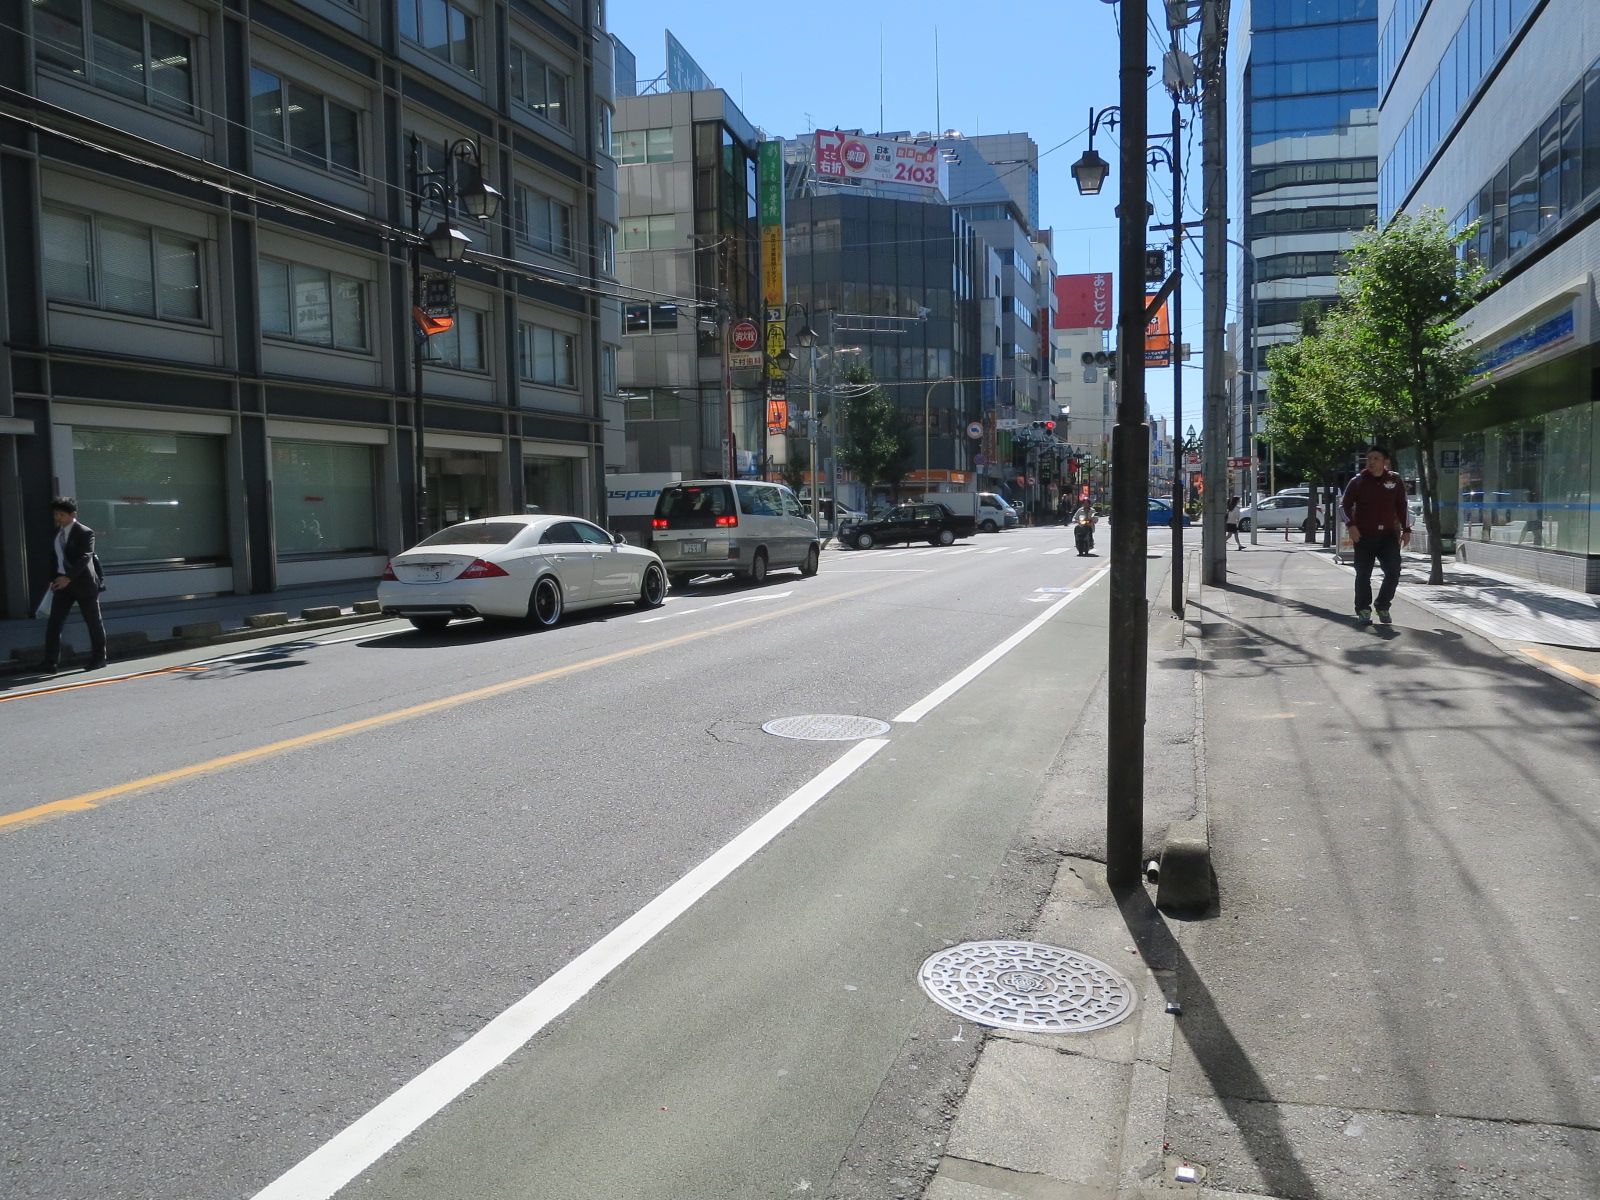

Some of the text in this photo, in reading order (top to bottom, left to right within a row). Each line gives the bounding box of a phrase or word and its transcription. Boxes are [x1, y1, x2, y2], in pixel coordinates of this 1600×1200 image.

[823, 151, 837, 160] ここ
[876, 146, 889, 154] 日本
[847, 150, 866, 163] 楽園
[820, 161, 842, 174] 右折
[895, 162, 936, 184] 2103
[735, 331, 755, 342] 消火栓
